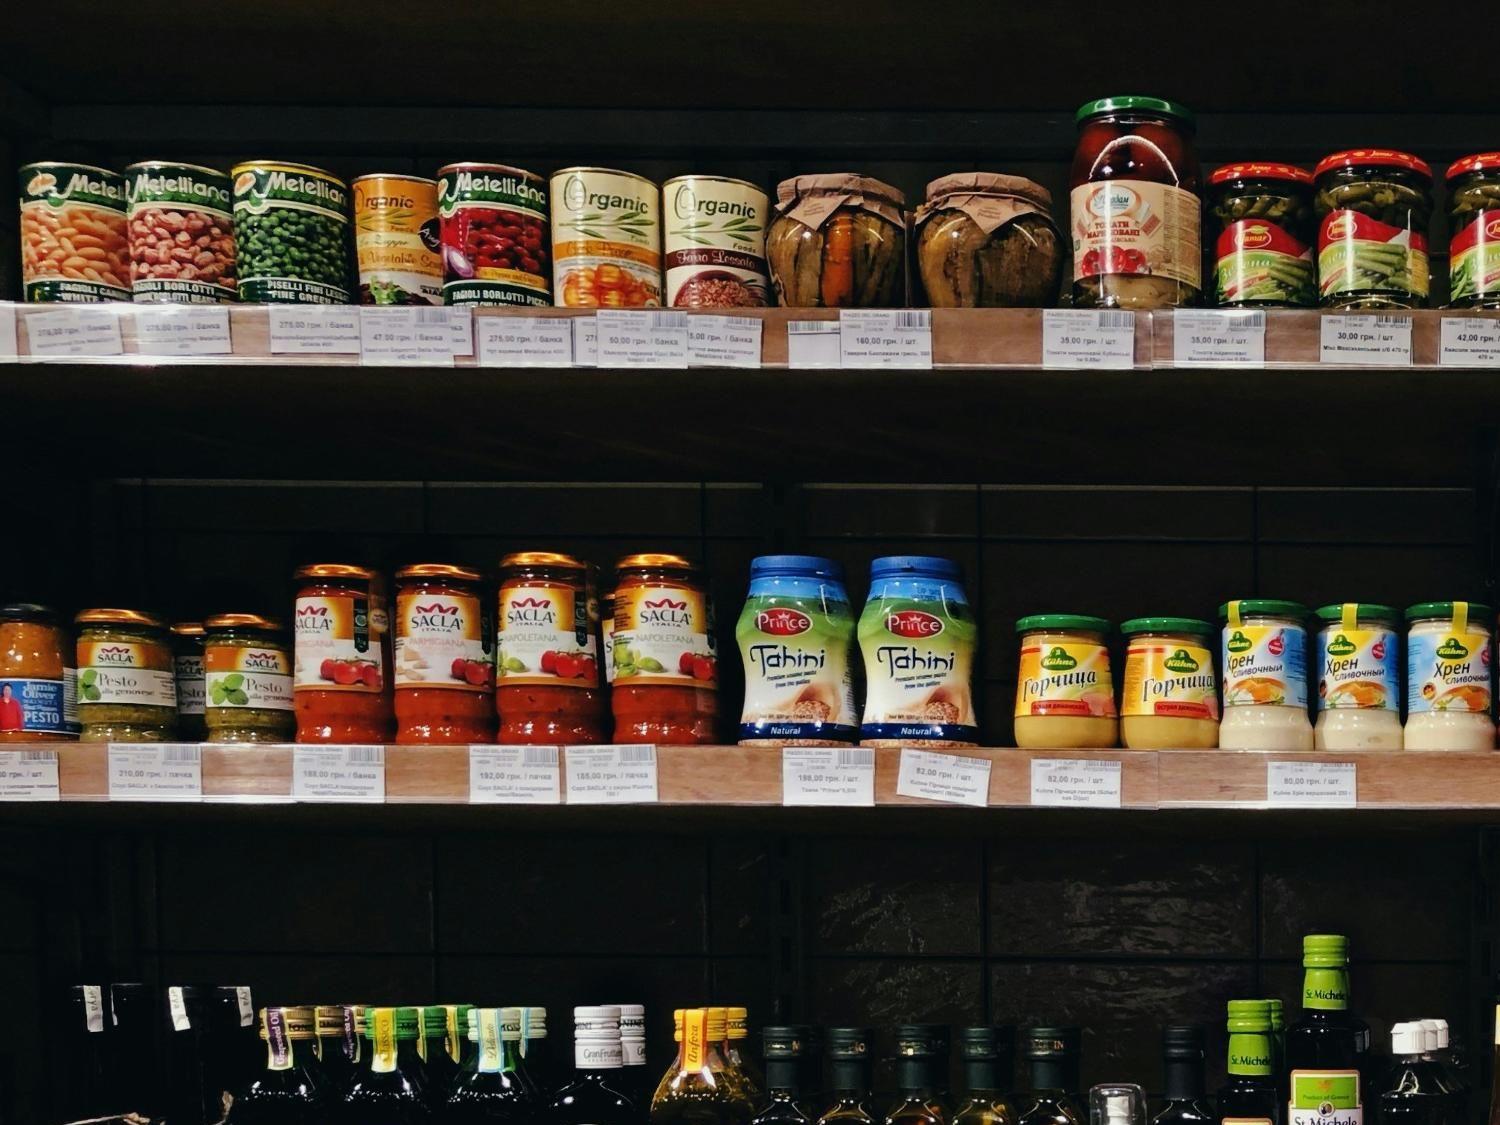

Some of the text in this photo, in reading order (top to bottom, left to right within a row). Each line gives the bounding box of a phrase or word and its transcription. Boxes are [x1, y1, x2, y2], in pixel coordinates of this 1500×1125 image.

[564, 175, 649, 214] Organic
[674, 185, 756, 220] Organic
[267, 279, 302, 291] PISELLI
[757, 612, 808, 632] Prince
[888, 615, 940, 633] Prince
[751, 645, 824, 676] Tahini
[878, 647, 955, 677] Tahini
[1043, 658, 1075, 667] Kühne
[1167, 661, 1198, 670] Kühne
[1227, 654, 1254, 672] Хрен
[1326, 658, 1358, 676] Хрен
[1233, 664, 1282, 679] сливочный
[1335, 668, 1384, 681] сливочный
[100, 674, 137, 687] Pesto
[246, 679, 282, 693] Pesto
[1023, 669, 1096, 702] Горчица
[1145, 671, 1213, 702] Горчица
[22, 690, 56, 699] Oliver
[24, 711, 59, 725] PESTO
[771, 726, 800, 735] Natural
[901, 726, 932, 736] Natural
